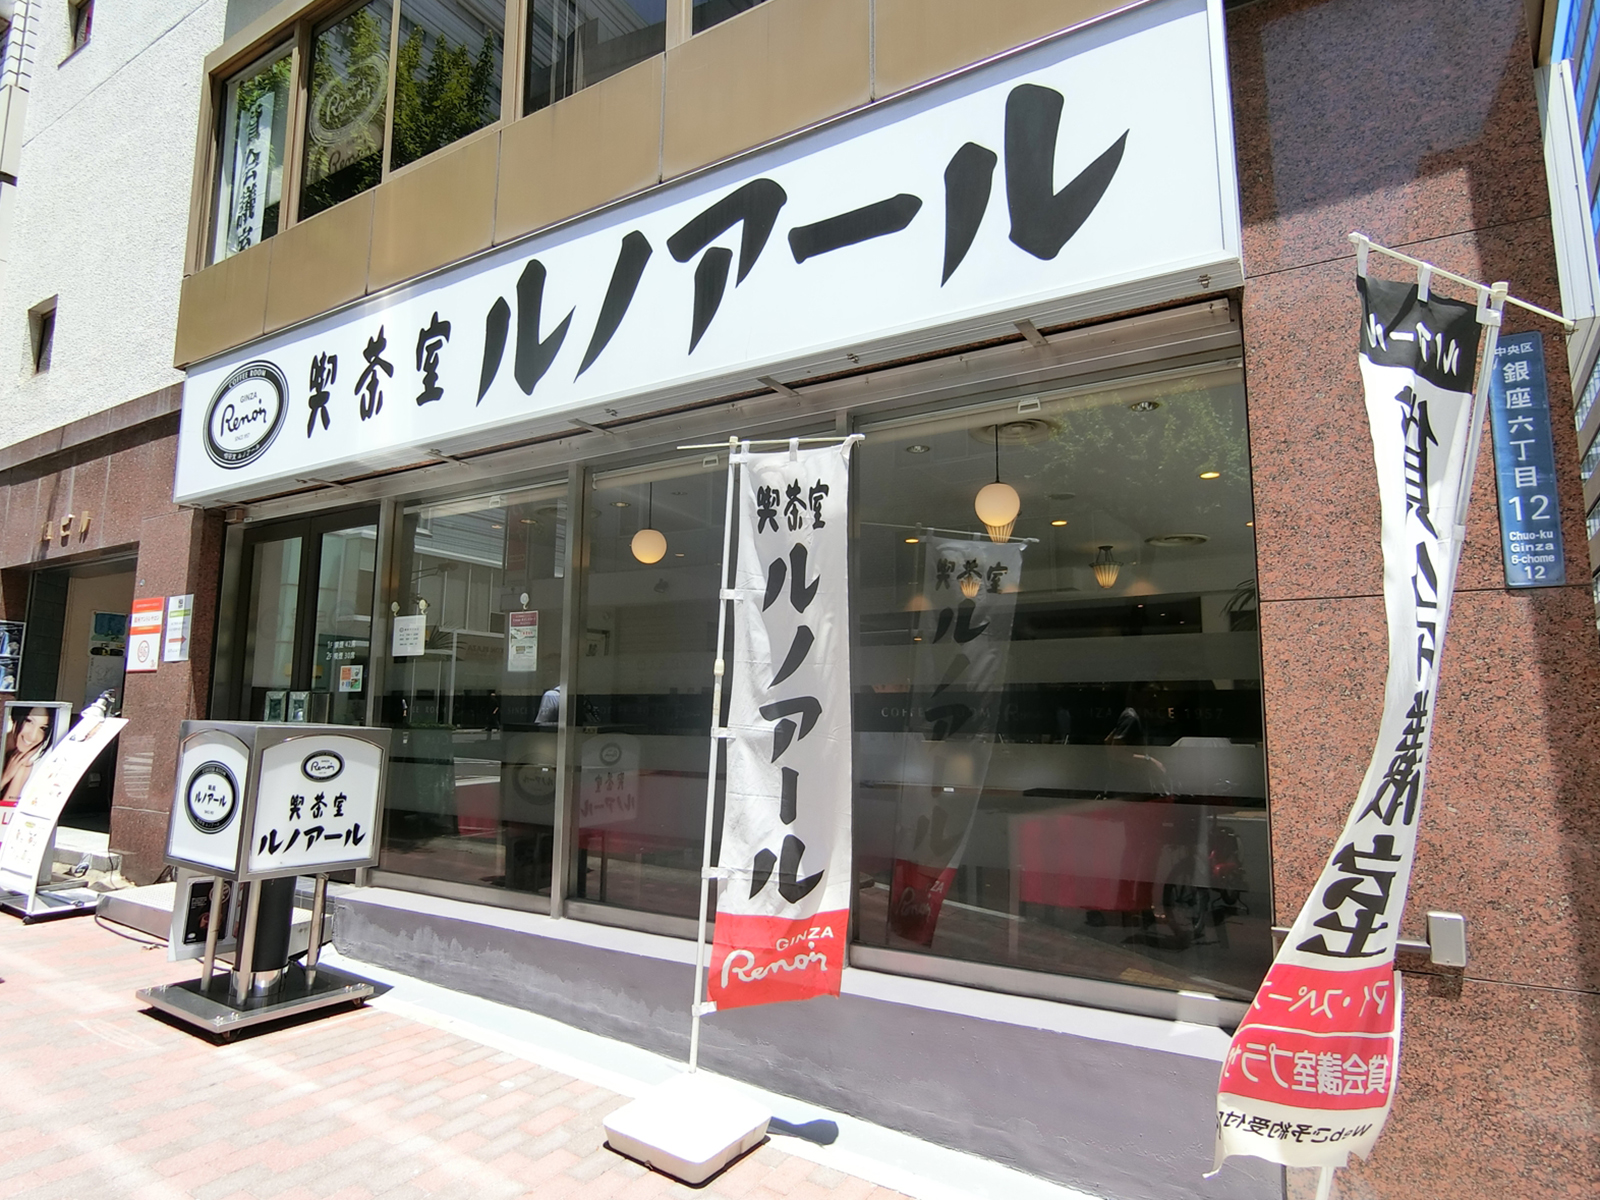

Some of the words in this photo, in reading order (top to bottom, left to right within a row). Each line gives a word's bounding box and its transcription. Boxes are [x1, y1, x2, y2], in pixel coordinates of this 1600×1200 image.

[307, 311, 451, 438] 喫茶室
[476, 83, 1130, 408] ルノアール
[1495, 342, 1534, 356] 中央区
[228, 371, 249, 389] COFFEE
[249, 369, 267, 377] ROOM
[240, 391, 258, 404] GINZA
[220, 398, 267, 437] Renoir
[1503, 360, 1538, 489] 銀座六丁目
[757, 478, 829, 533] 喫茶室
[1509, 494, 1550, 521] 12
[1509, 529, 1553, 541] Chuo-ku
[1510, 542, 1555, 553] Ginza
[1511, 554, 1555, 565] 6-chome
[1524, 565, 1546, 580] 12
[749, 542, 825, 904] ルノアール
[881, 706, 932, 718] COFFE
[194, 790, 227, 808] ルノアール
[289, 791, 347, 821] 喫茶室
[257, 823, 366, 856] ルノアール
[776, 926, 834, 951] GINZA
[721, 941, 828, 989] Renoir
